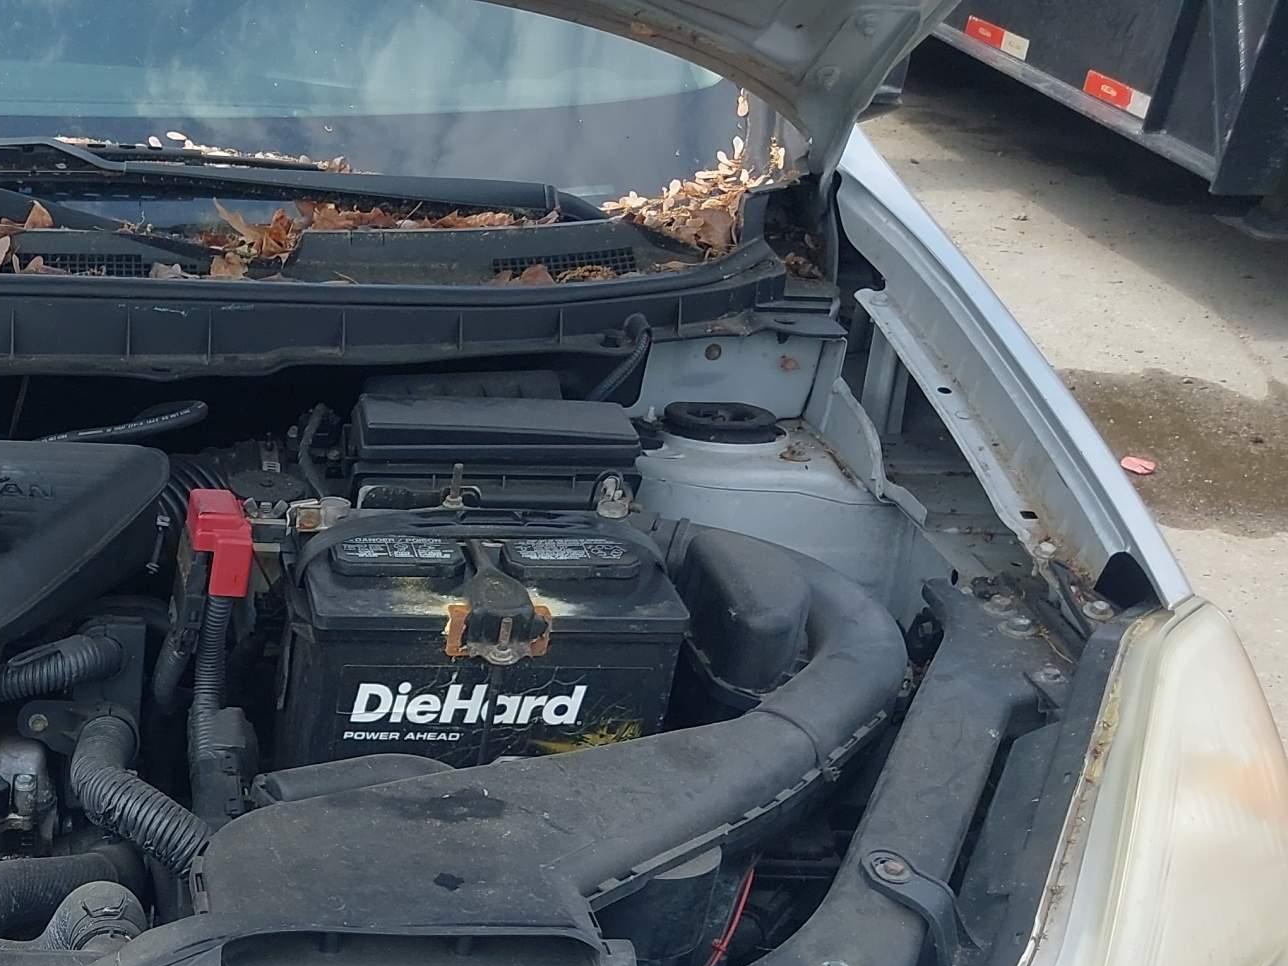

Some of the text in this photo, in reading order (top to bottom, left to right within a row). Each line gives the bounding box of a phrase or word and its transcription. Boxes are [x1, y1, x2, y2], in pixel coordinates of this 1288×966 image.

[349, 682, 588, 725] DieHard
[343, 732, 460, 741] POWER AHEAD
